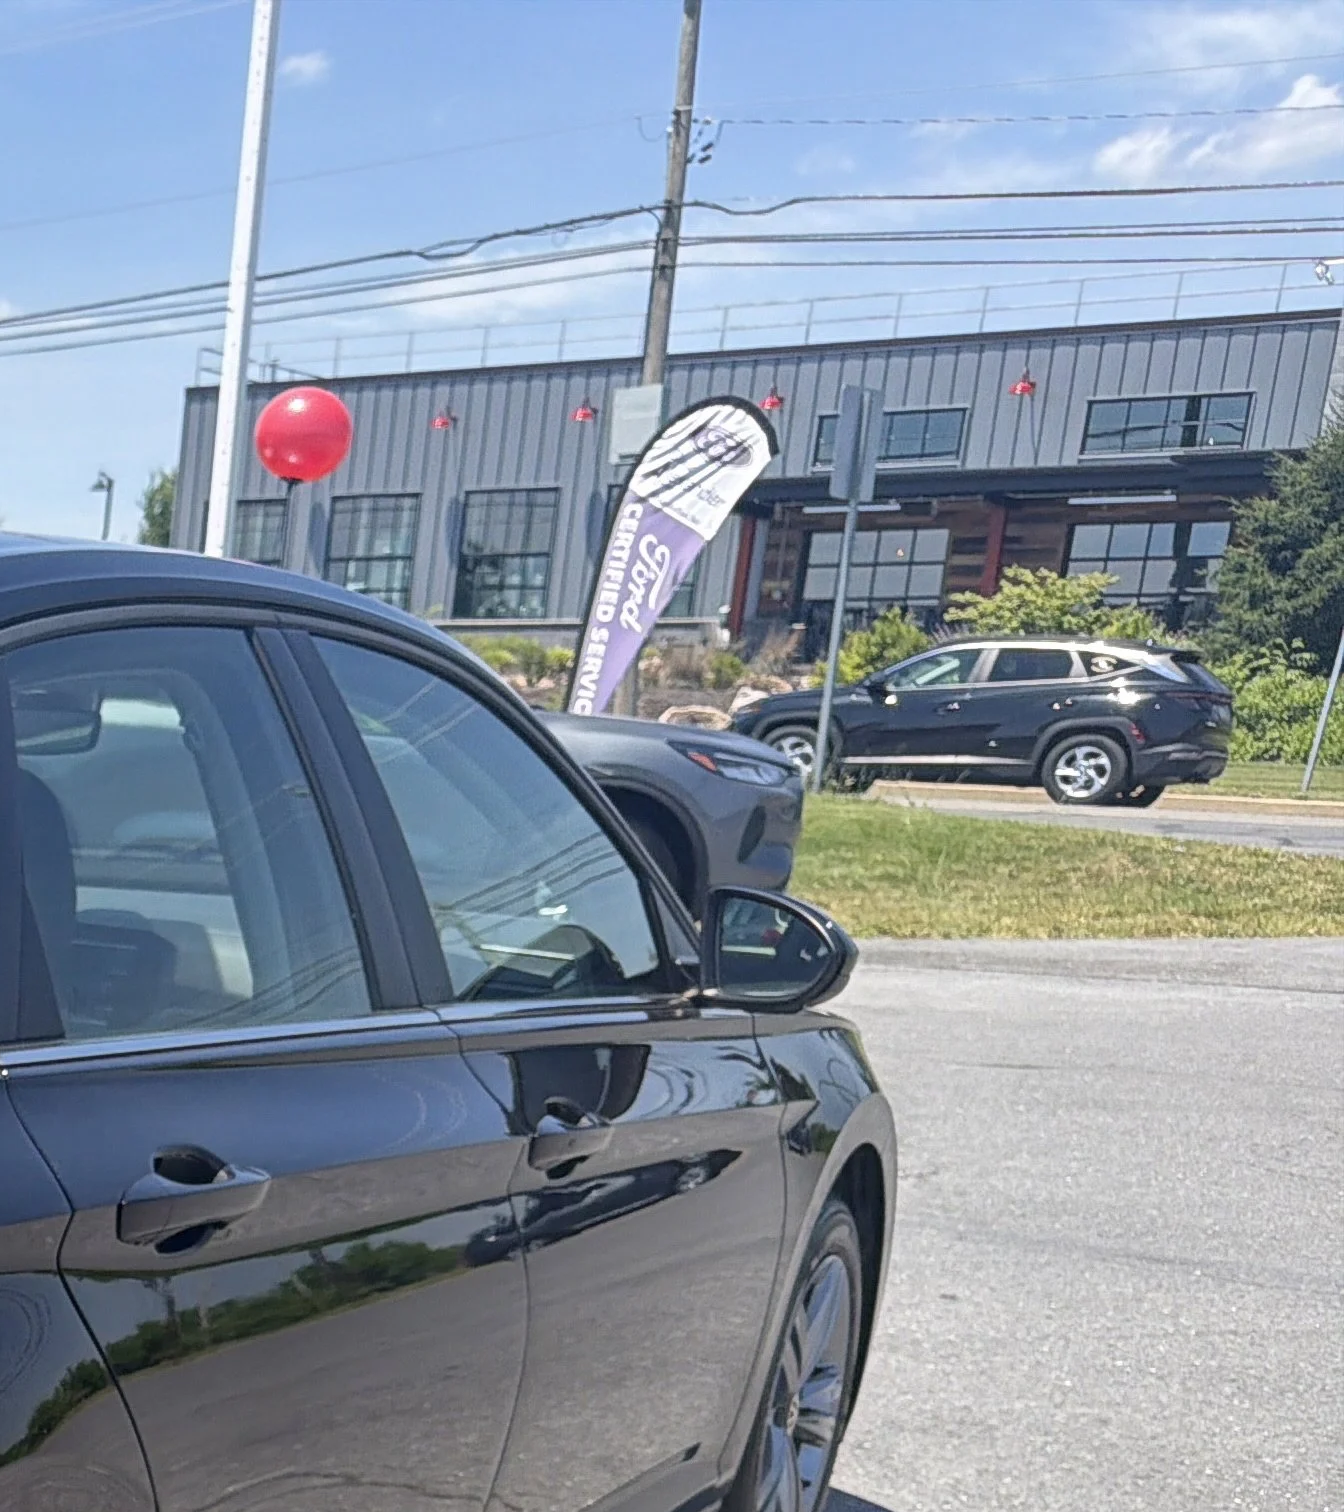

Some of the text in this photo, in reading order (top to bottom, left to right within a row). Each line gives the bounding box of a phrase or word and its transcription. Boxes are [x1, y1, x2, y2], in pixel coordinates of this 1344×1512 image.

[573, 503, 644, 715] CERTIFIED SERVIC
[619, 533, 671, 633] Ford
